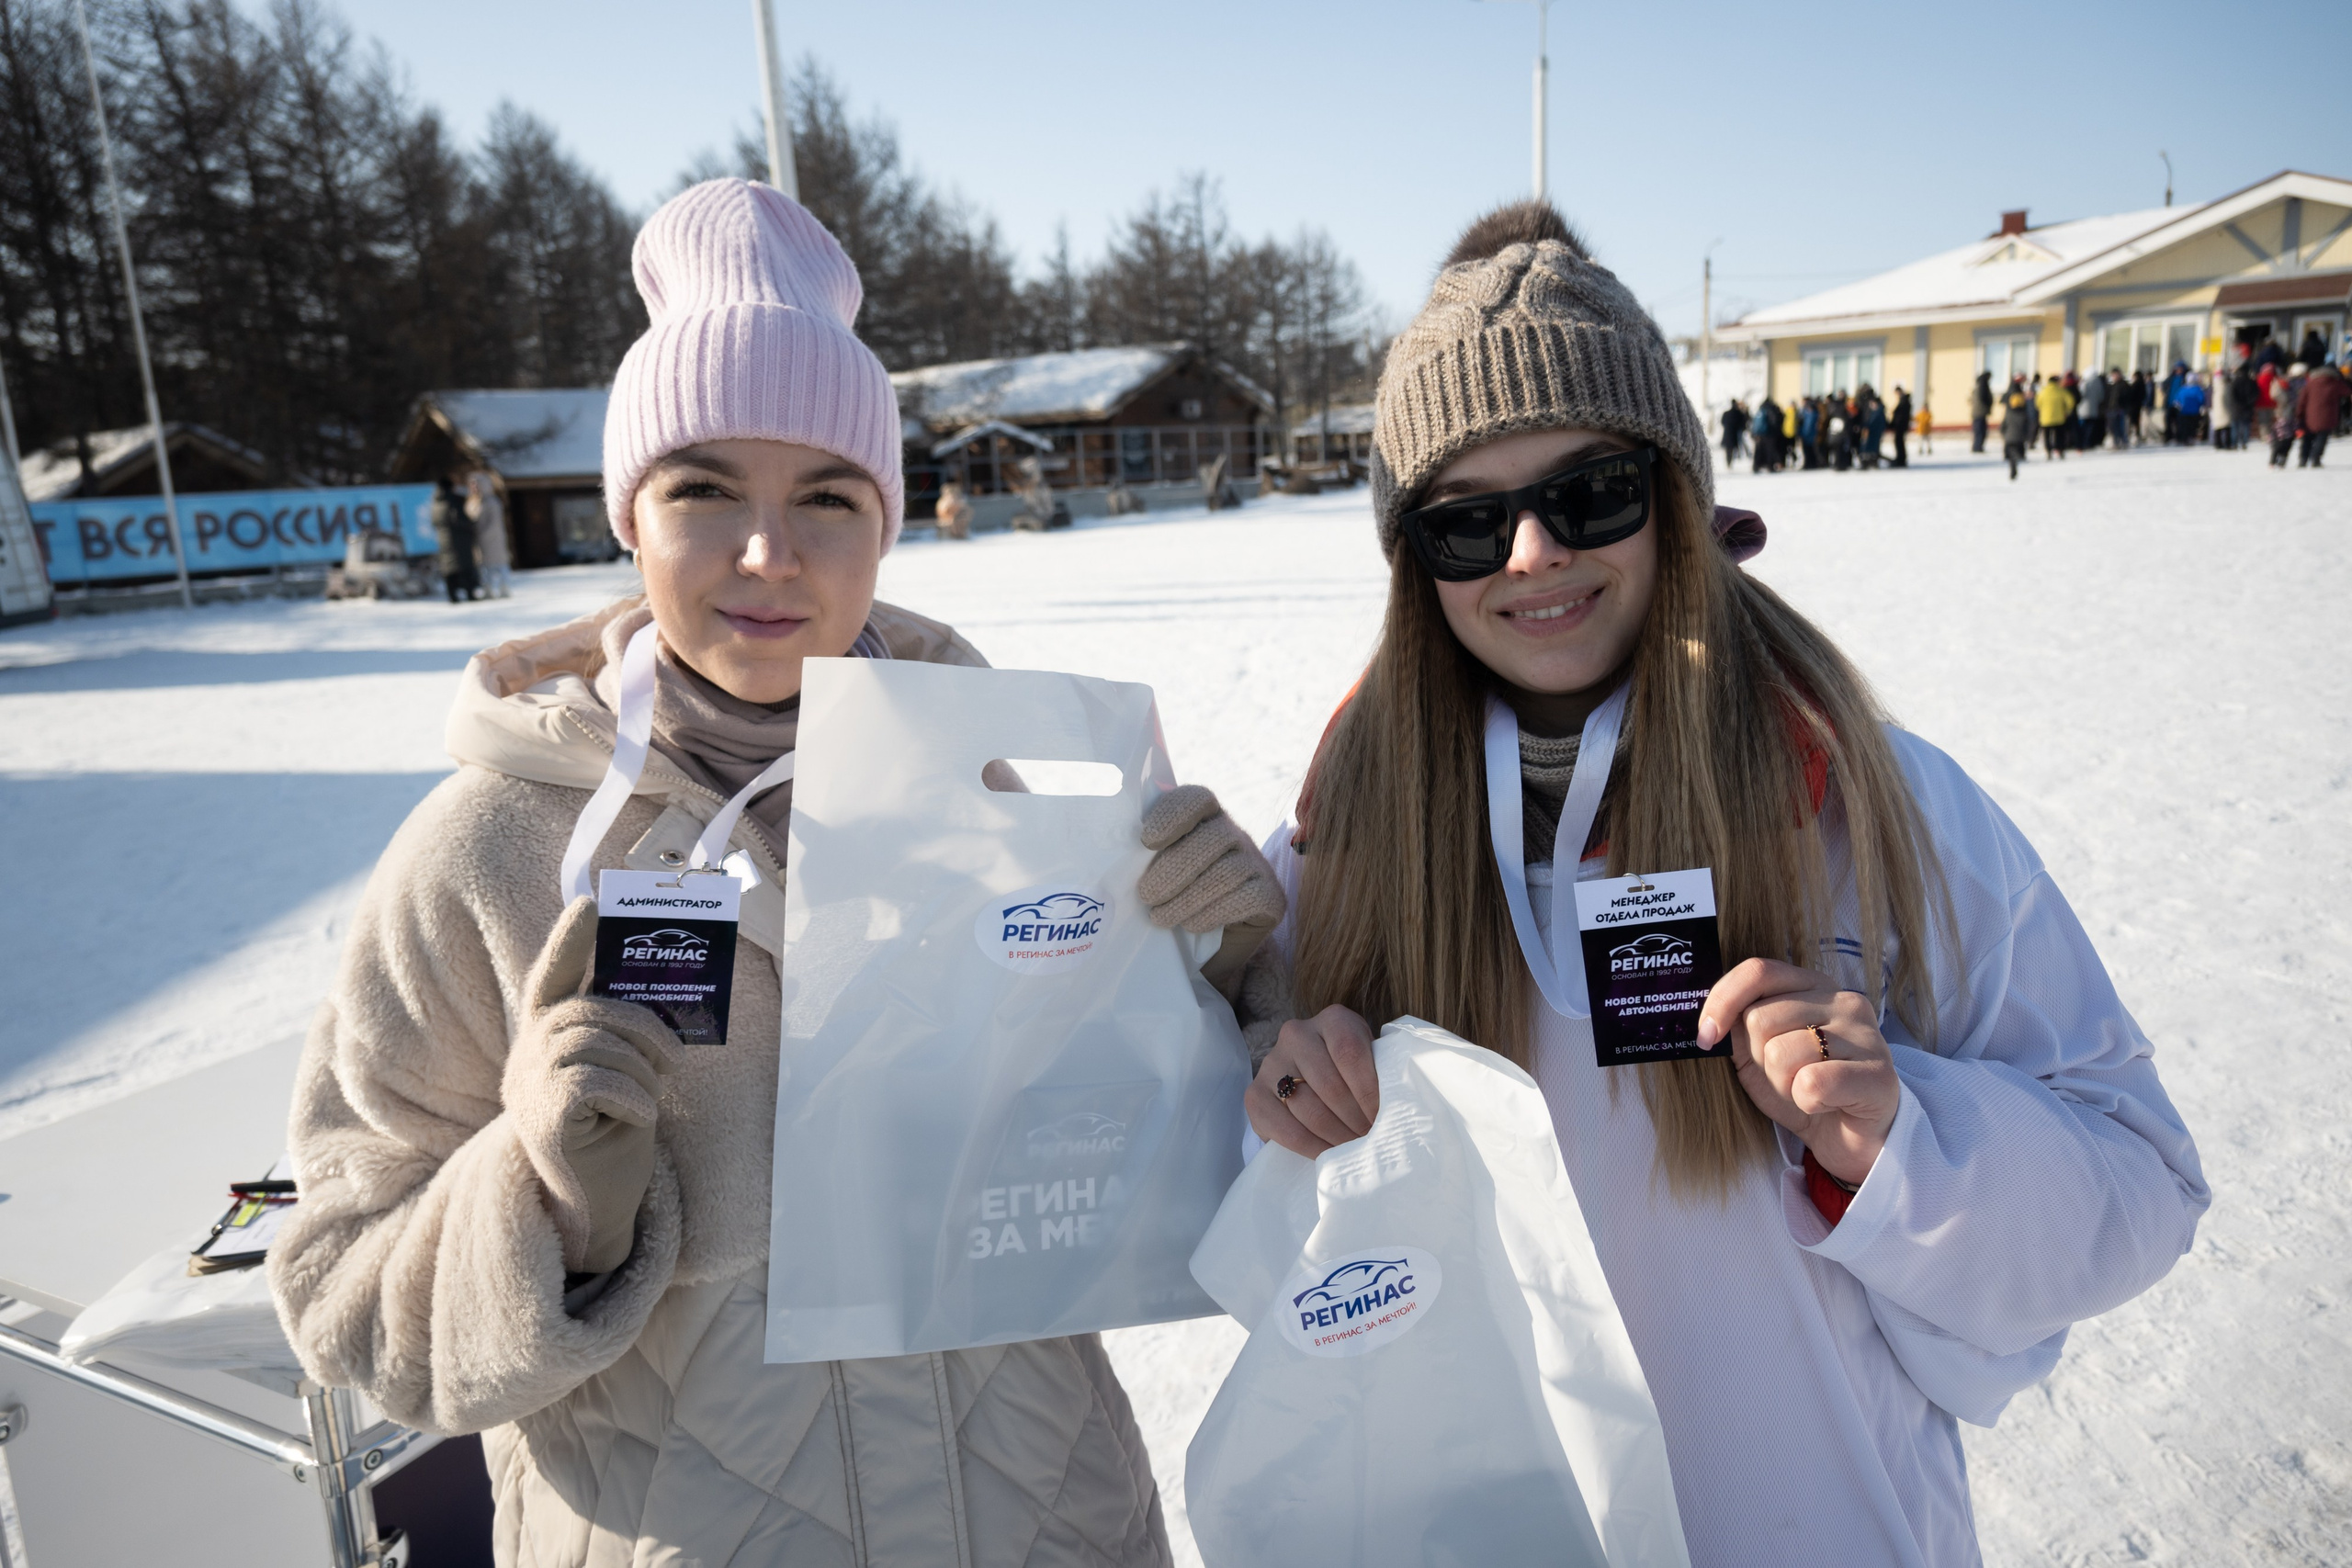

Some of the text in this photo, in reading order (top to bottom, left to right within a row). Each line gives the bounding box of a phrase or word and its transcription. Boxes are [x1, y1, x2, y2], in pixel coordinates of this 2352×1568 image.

[79, 516, 176, 559] ВСЯ
[196, 503, 401, 553] РОССИЯ!
[616, 897, 722, 908] АДМИНИСТРАТОР
[1611, 891, 1675, 908] МЕНЕДЖЕР
[1595, 903, 1695, 922] ОТДЕЛА ПРОДАЖ
[1001, 918, 1102, 942] РЕГИНАС
[621, 947, 707, 961] РЕГИНАС
[1016, 949, 1053, 958] РЕГИНАС
[1066, 942, 1092, 954] МЕЧТОЙ!
[1611, 952, 1693, 972] РЕГИНАС
[1611, 971, 1646, 980] ОСНОВАН
[1673, 966, 1693, 975] ГОДУ
[608, 982, 716, 991] НОВОЕ ПОКОЛЕНИЕ
[621, 992, 703, 1001] АВТОМОБИЛЕЙ
[1604, 989, 1709, 1007] НОВОЕ ПОКОЛЕНИЕ
[1618, 999, 1698, 1016] АВТОМОБИЛЕЙ
[1623, 1043, 1659, 1053] РЕГИНАС
[1675, 1040, 1696, 1048] МЕЧТ
[981, 1175, 1125, 1220] ЕГИНА
[967, 1223, 1027, 1260] ЗА
[1300, 1274, 1416, 1331] РЕГИНАС
[1321, 1325, 1363, 1346] РЕГИНАС
[1364, 1321, 1376, 1331] ЗА
[1378, 1302, 1418, 1325] МЕЧТОЙ!
